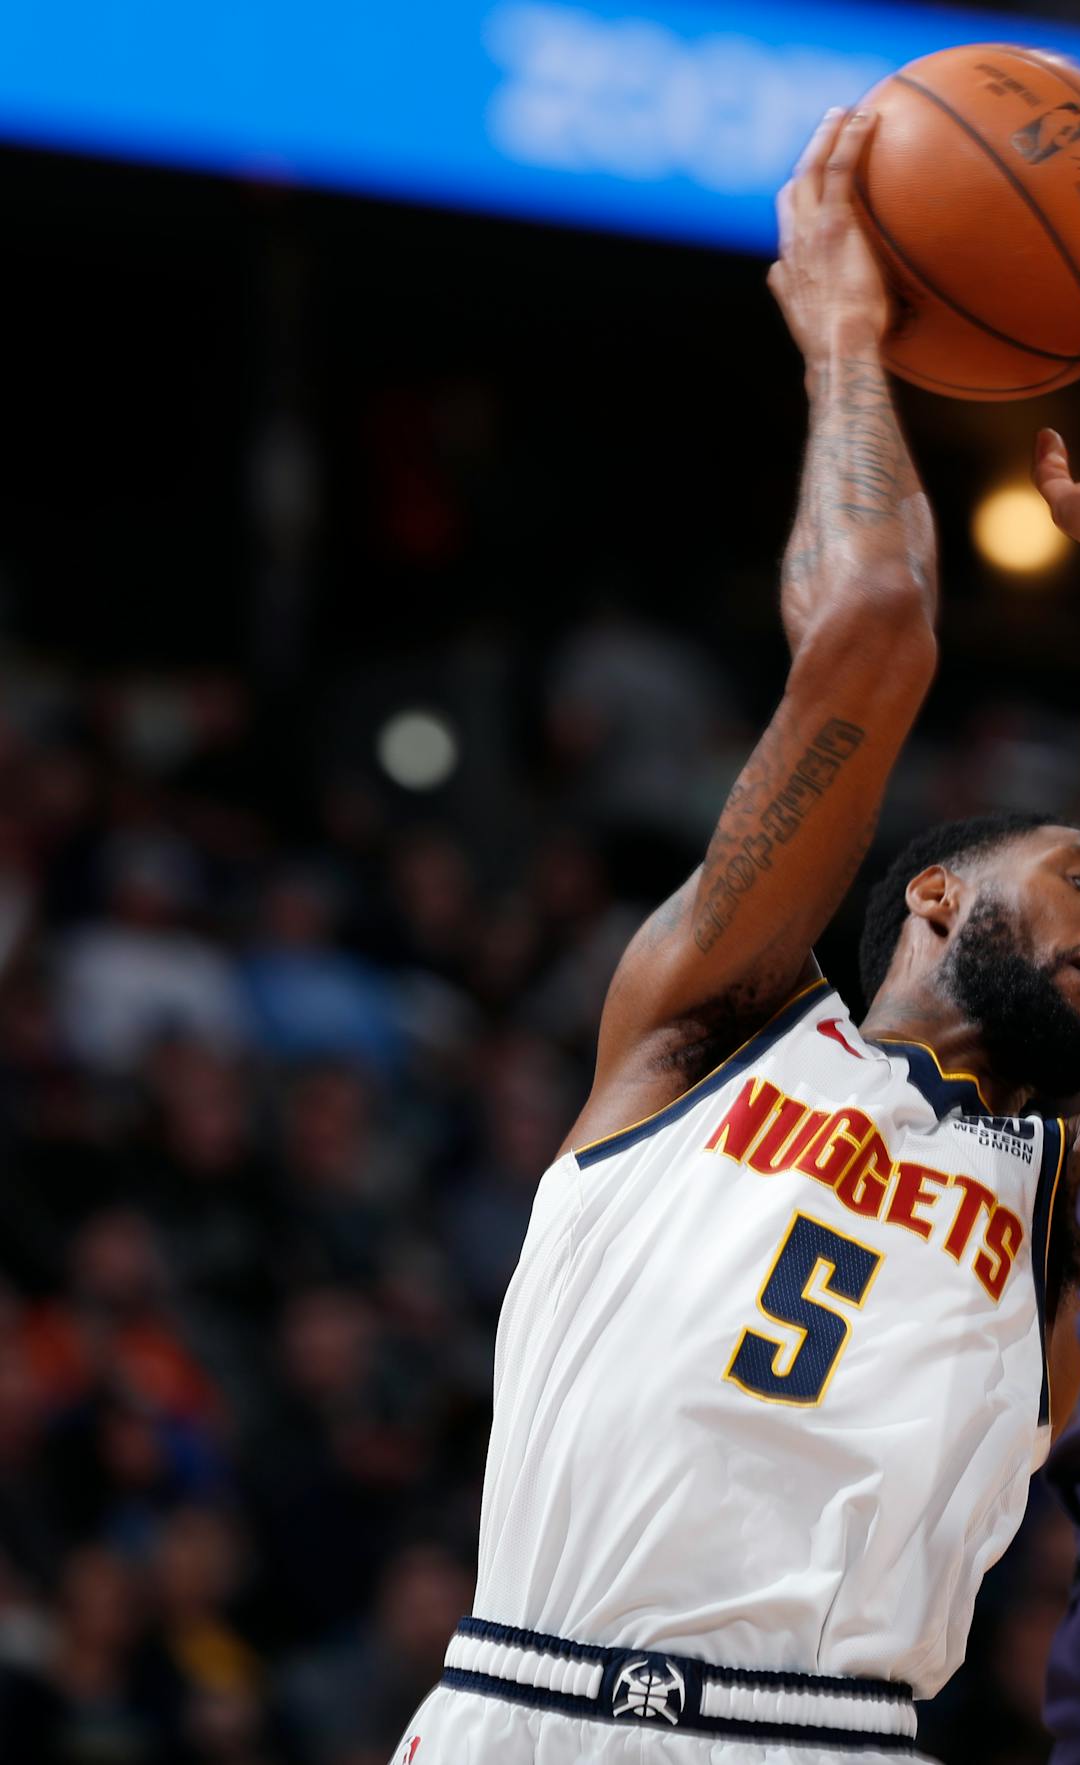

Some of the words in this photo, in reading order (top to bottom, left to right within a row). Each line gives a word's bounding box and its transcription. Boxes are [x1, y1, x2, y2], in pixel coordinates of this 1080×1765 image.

[704, 1076, 1025, 1304] NUGGETS
[953, 1122, 1034, 1155] WESTERN
[978, 1136, 1032, 1165] UNION
[721, 1208, 886, 1408] 5
